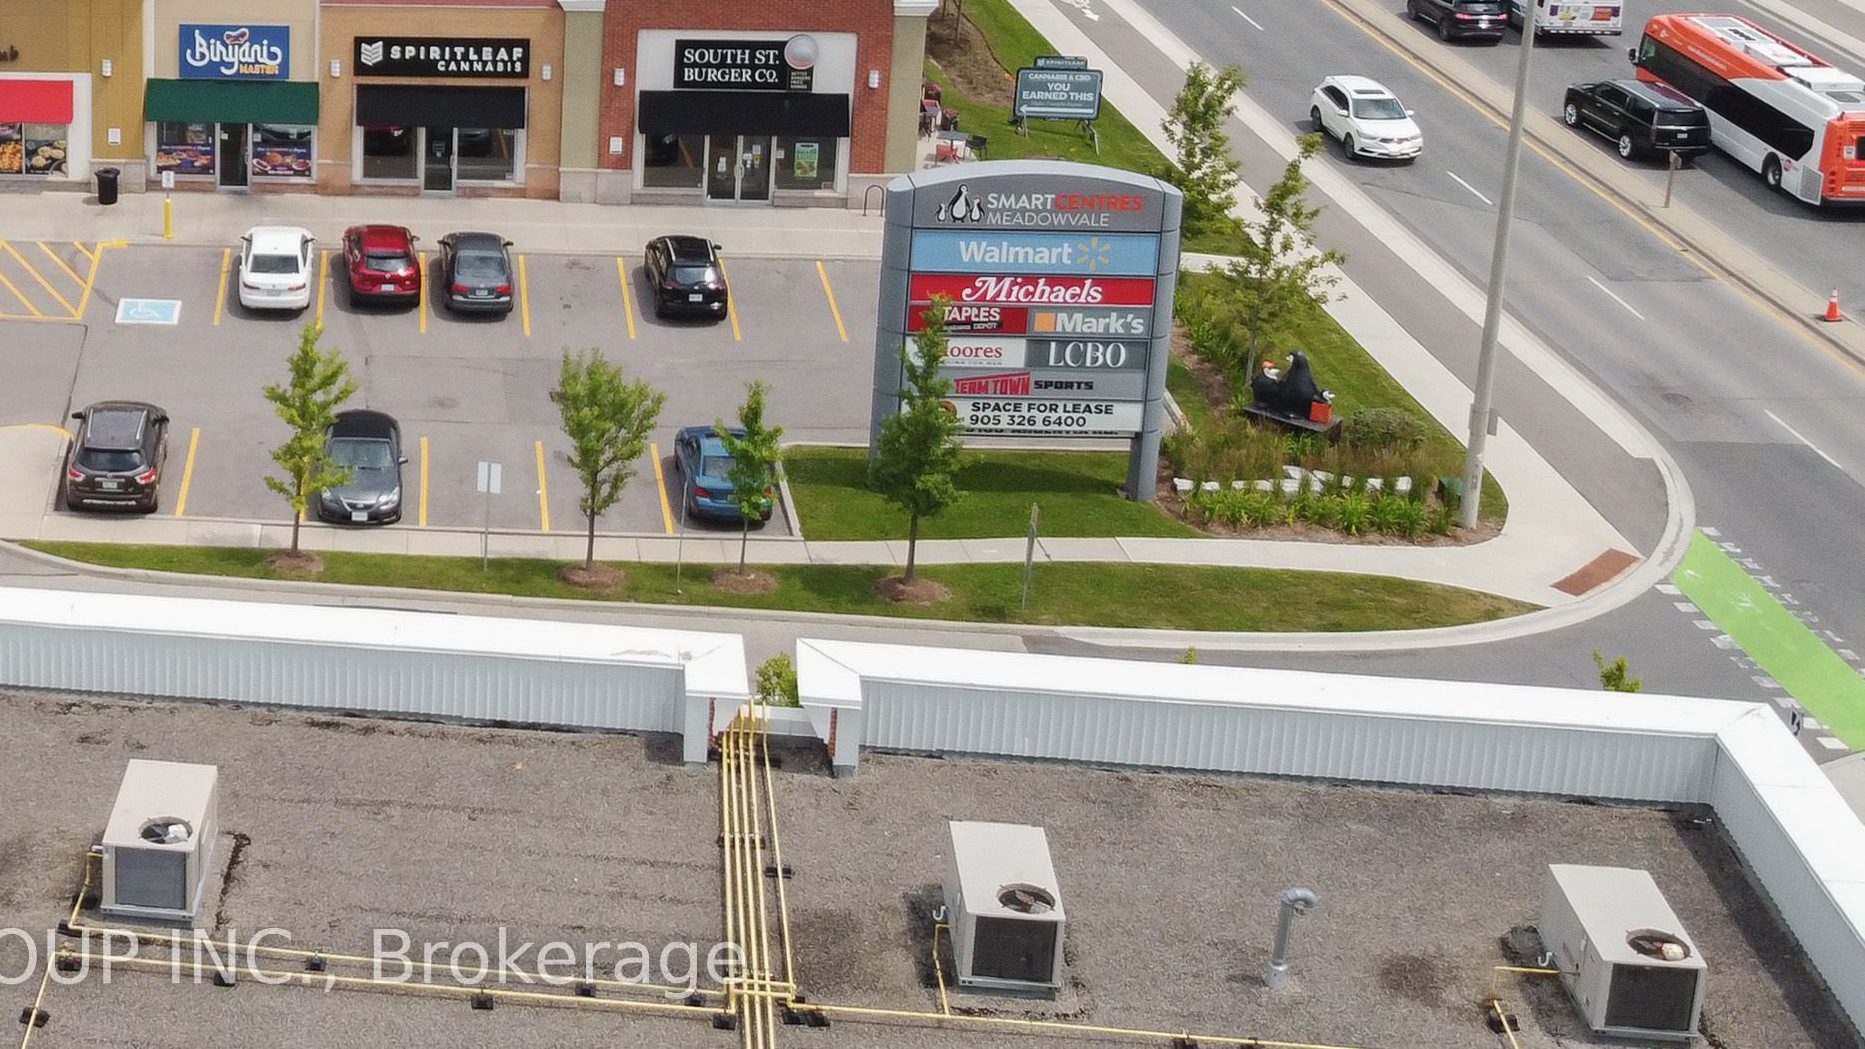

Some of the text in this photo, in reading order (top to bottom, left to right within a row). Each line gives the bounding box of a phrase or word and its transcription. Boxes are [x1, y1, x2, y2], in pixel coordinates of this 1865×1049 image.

[186, 29, 282, 75] Biryani
[390, 45, 523, 61] SPIRITLEAF
[684, 48, 779, 65] SOUTH ST.
[437, 60, 522, 72] CANNABIS
[684, 67, 779, 83] BURGER CO.
[1028, 73, 1068, 81] CANNABIS
[1047, 82, 1071, 91] YOU
[1022, 90, 1094, 101] EARNED THIS
[987, 193, 1143, 211] SMARTCENTRES
[986, 212, 1110, 227] MEADOWVALE
[959, 241, 1072, 264] Walmart
[962, 276, 1103, 303] Michaels
[942, 306, 1001, 322] TAPLES
[1056, 312, 1144, 334] Mark's
[1049, 341, 1126, 367] LCBO
[993, 372, 1031, 396] TOWN
[1034, 380, 1094, 390] SPORTS
[971, 402, 1114, 415] SPACE FOR LEASE
[970, 414, 1086, 428] 905 326 6400
